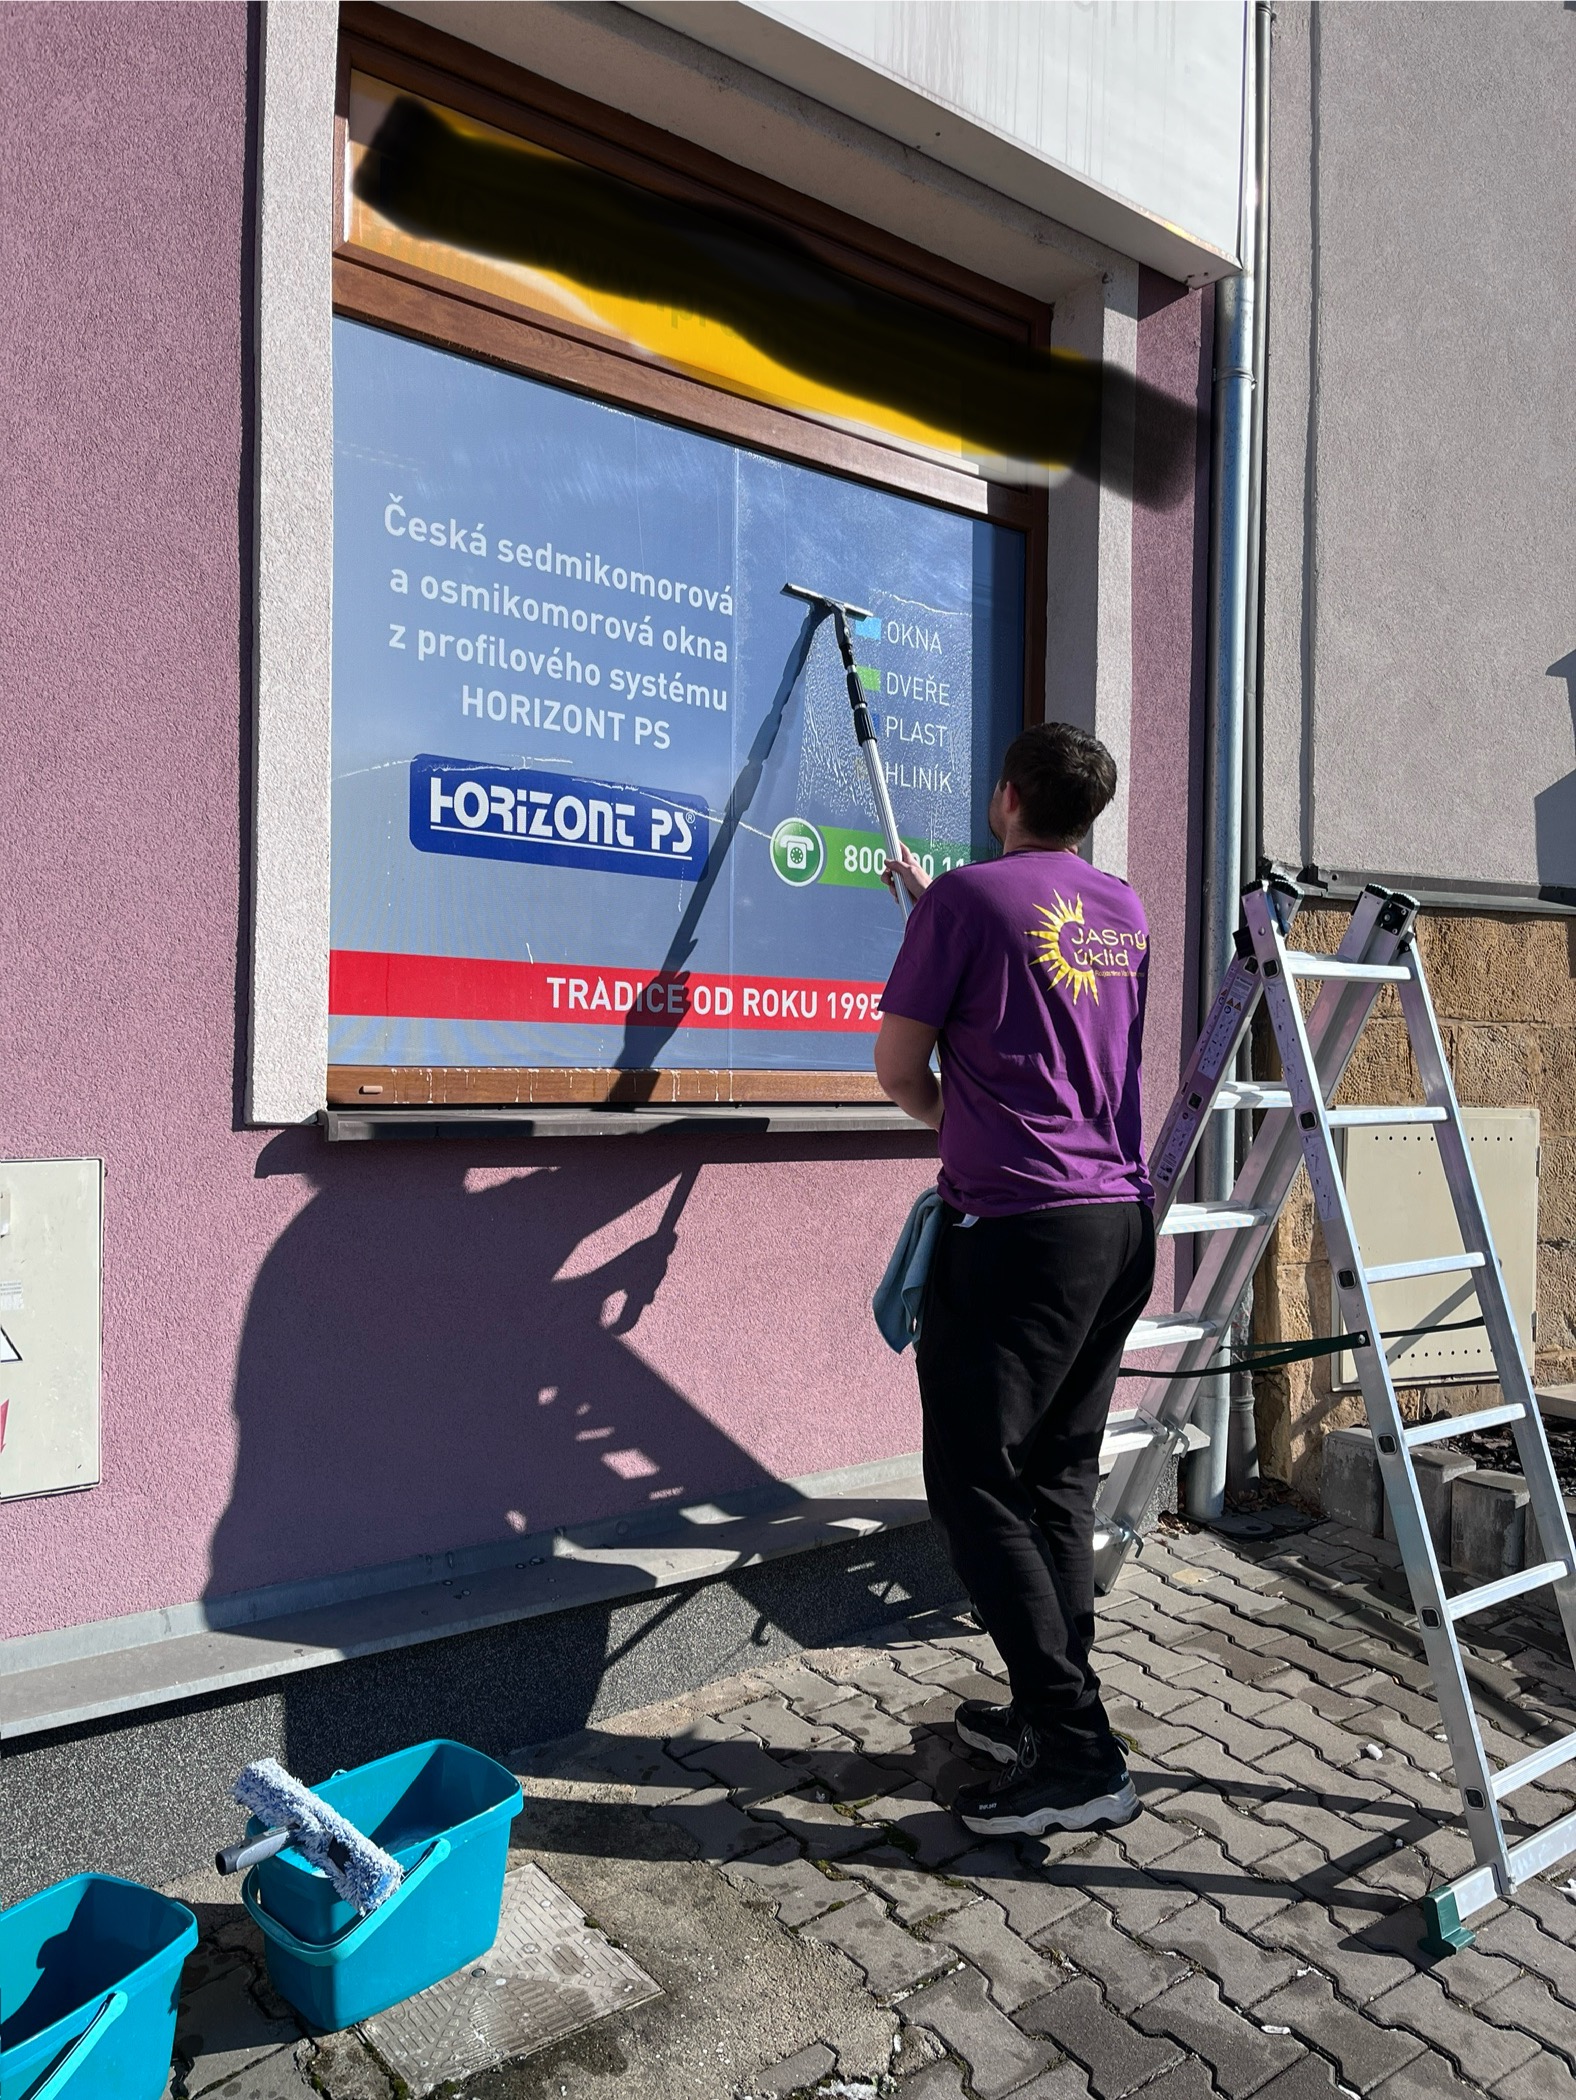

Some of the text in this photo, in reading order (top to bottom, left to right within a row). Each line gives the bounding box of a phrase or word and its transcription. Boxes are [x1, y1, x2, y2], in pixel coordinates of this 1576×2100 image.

[384, 492, 733, 616] Česká sedmikomorová
[389, 568, 728, 663] a osmikomorová okna
[886, 621, 943, 655] OKNA
[388, 623, 728, 712] z profilového systému
[886, 671, 951, 706] DVEŘE
[462, 684, 671, 750] HORIZONT PS
[886, 715, 948, 747] PLAST
[885, 762, 952, 793] HLINÍK
[843, 844, 887, 876] 800
[1073, 947, 1130, 967] úklid
[546, 976, 884, 1023] TRADICE OD ROKU 1995
